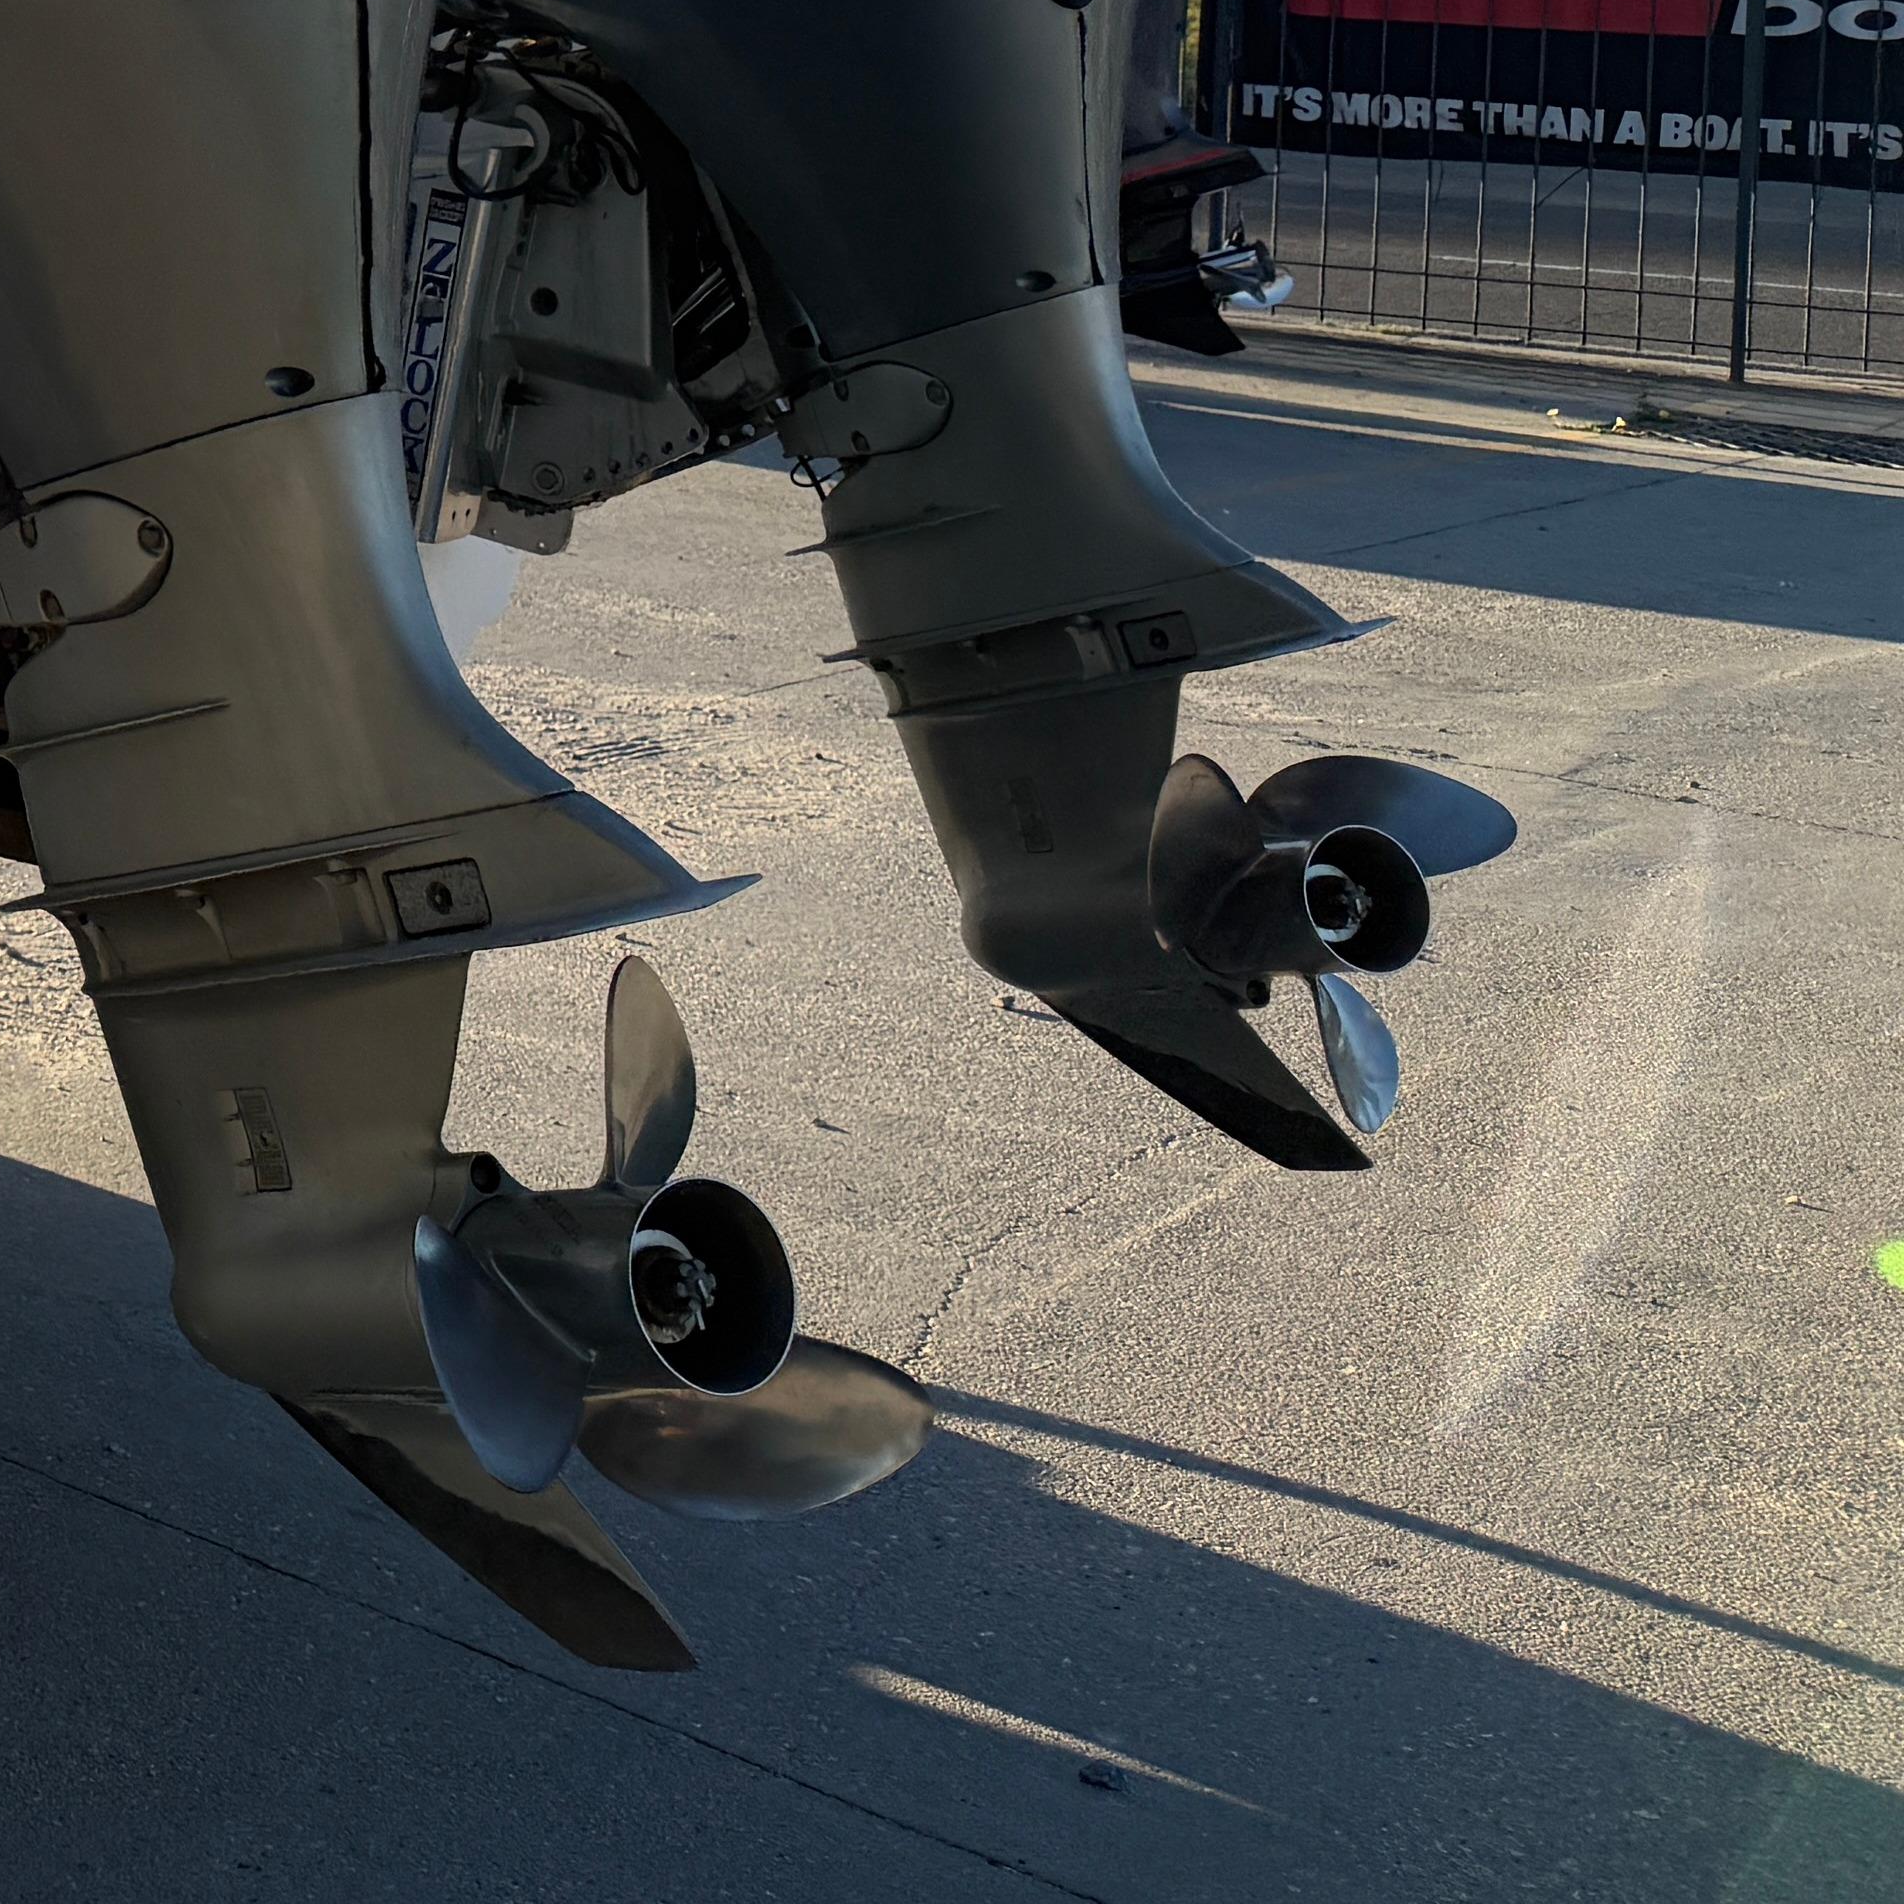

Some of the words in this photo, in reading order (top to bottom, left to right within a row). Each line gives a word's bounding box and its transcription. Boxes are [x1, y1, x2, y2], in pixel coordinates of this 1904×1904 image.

[1243, 83, 1322, 122] IT'S
[1331, 91, 1464, 132] MORE
[1472, 100, 1604, 144] THAN
[1613, 110, 1648, 146] A
[1808, 119, 1903, 161] IT'S
